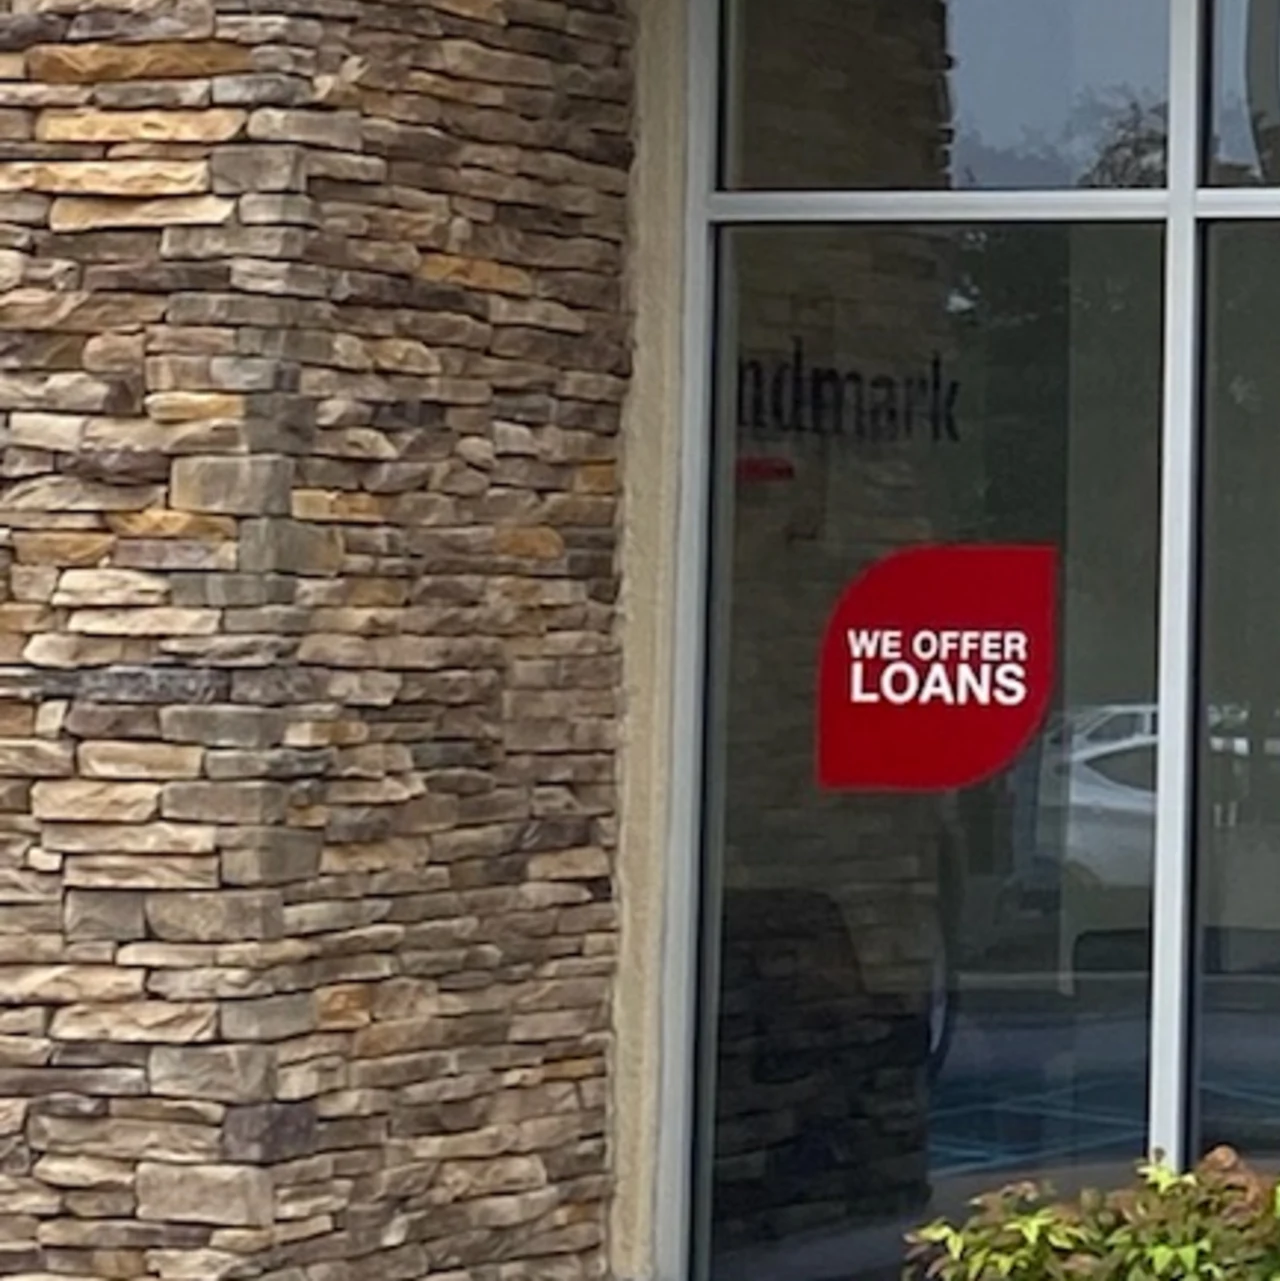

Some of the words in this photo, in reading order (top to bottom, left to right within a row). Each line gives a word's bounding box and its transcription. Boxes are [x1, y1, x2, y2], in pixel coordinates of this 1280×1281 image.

[847, 629, 902, 660] WE
[912, 629, 1028, 662] OFFER
[851, 660, 1027, 706] LOANS
